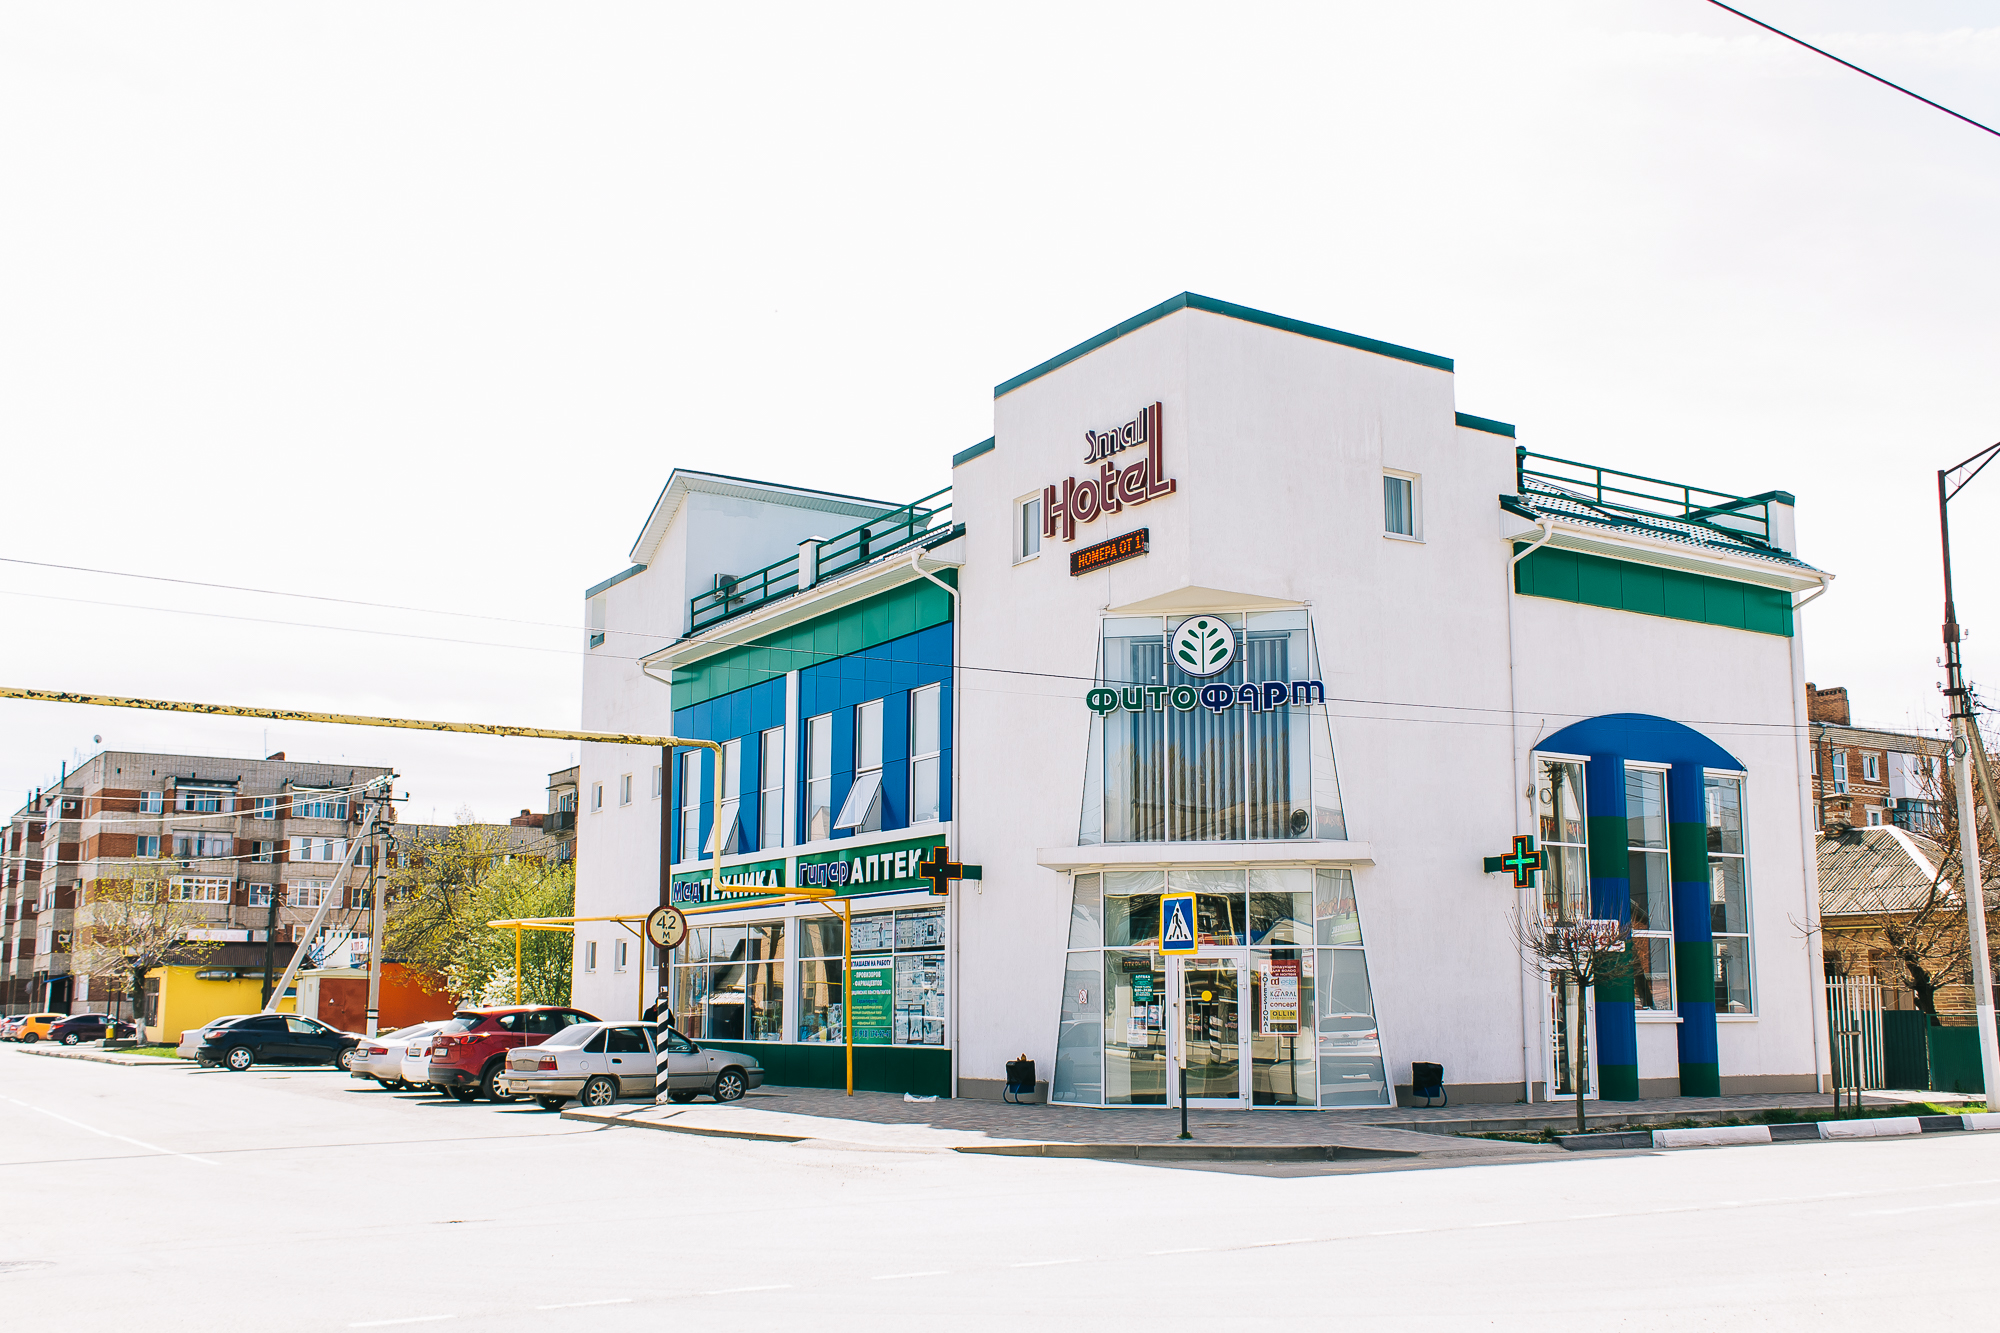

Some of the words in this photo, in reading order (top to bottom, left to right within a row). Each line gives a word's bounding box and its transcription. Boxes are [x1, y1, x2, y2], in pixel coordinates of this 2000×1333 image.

[1078, 543, 1118, 568] НОМЕРА
[1119, 538, 1133, 553] ОТ
[798, 847, 931, 888] ГиперАПТЕК
[1270, 1001, 1297, 1009] concept
